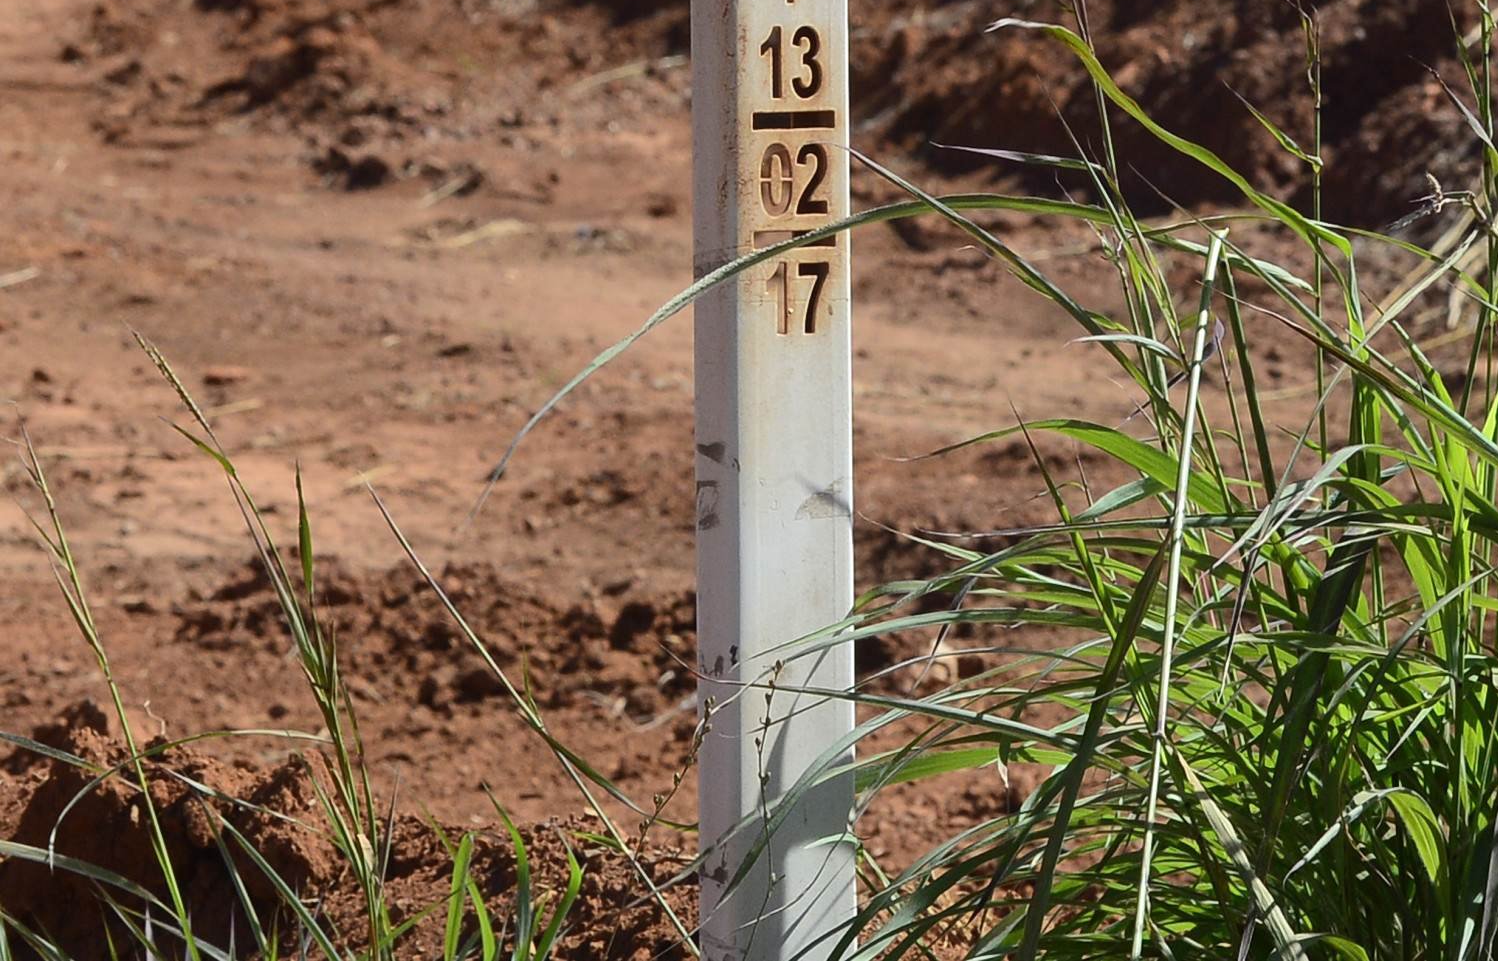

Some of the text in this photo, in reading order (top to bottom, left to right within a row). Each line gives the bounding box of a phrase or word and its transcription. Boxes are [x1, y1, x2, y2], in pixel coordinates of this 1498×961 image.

[760, 25, 823, 100] 13
[760, 142, 830, 217] 02
[766, 261, 831, 335] 17
